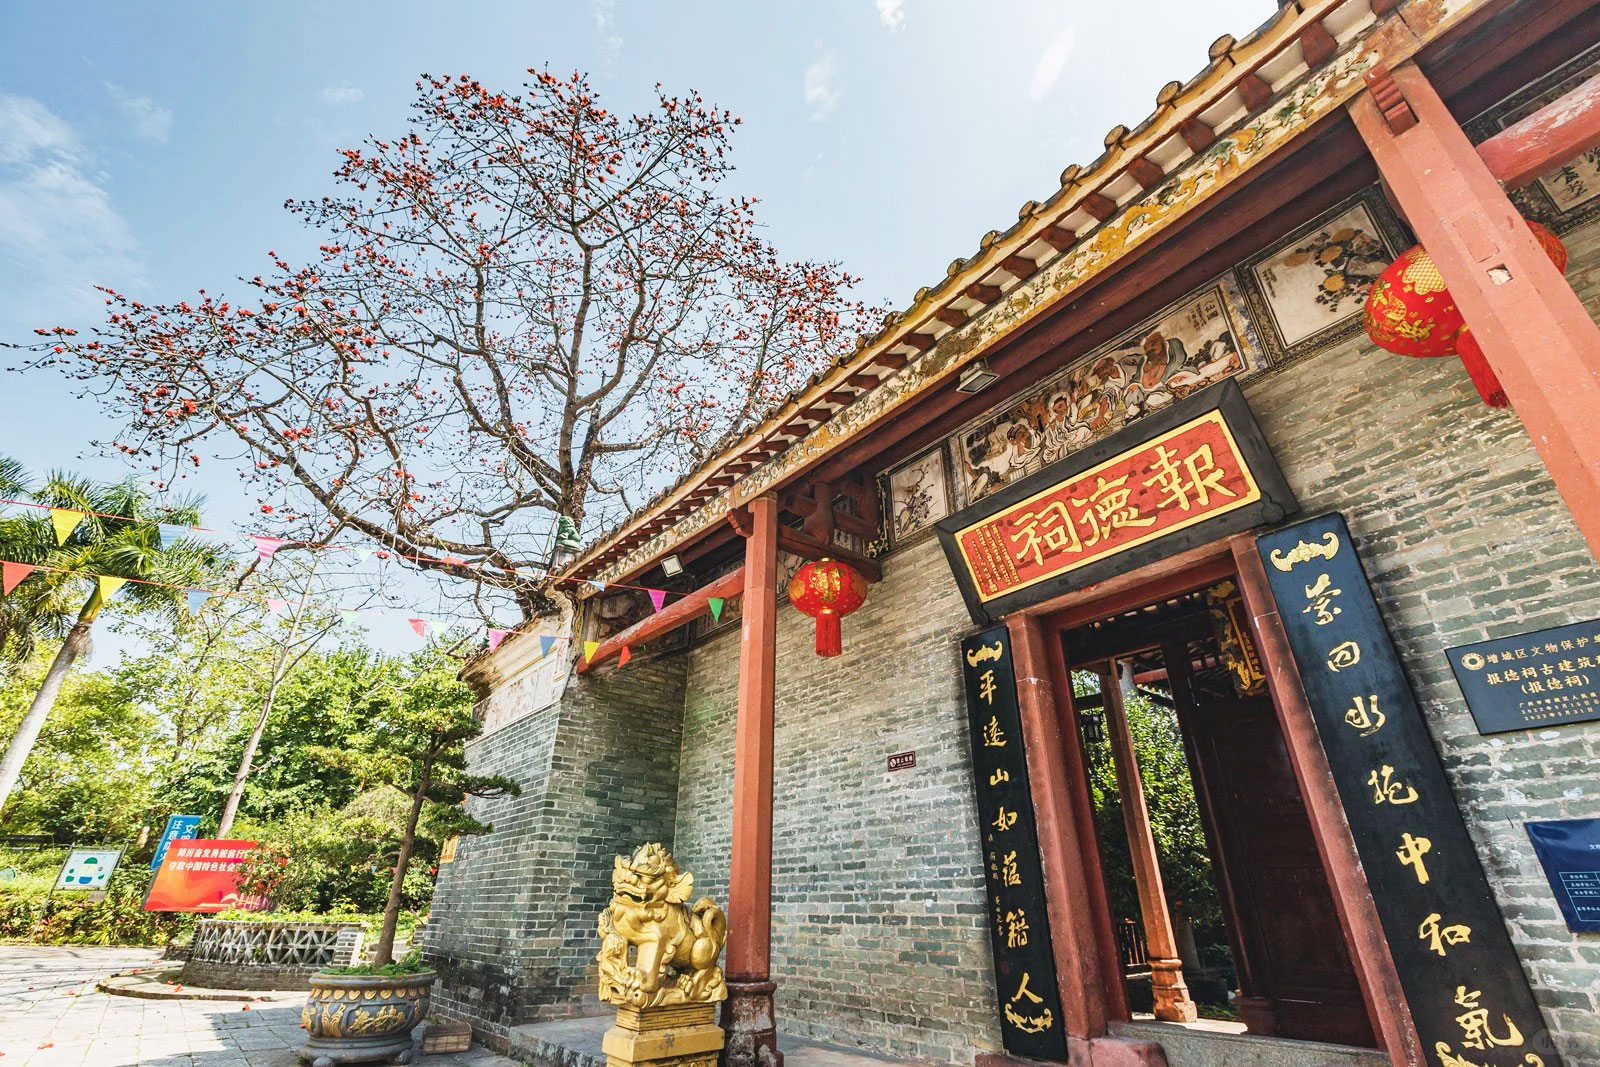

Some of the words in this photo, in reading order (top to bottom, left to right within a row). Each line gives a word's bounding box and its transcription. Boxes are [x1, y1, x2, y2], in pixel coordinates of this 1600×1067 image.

[1521, 674, 1590, 694] (报德祠)
[168, 861, 241, 872] 夺取中国特色社会
